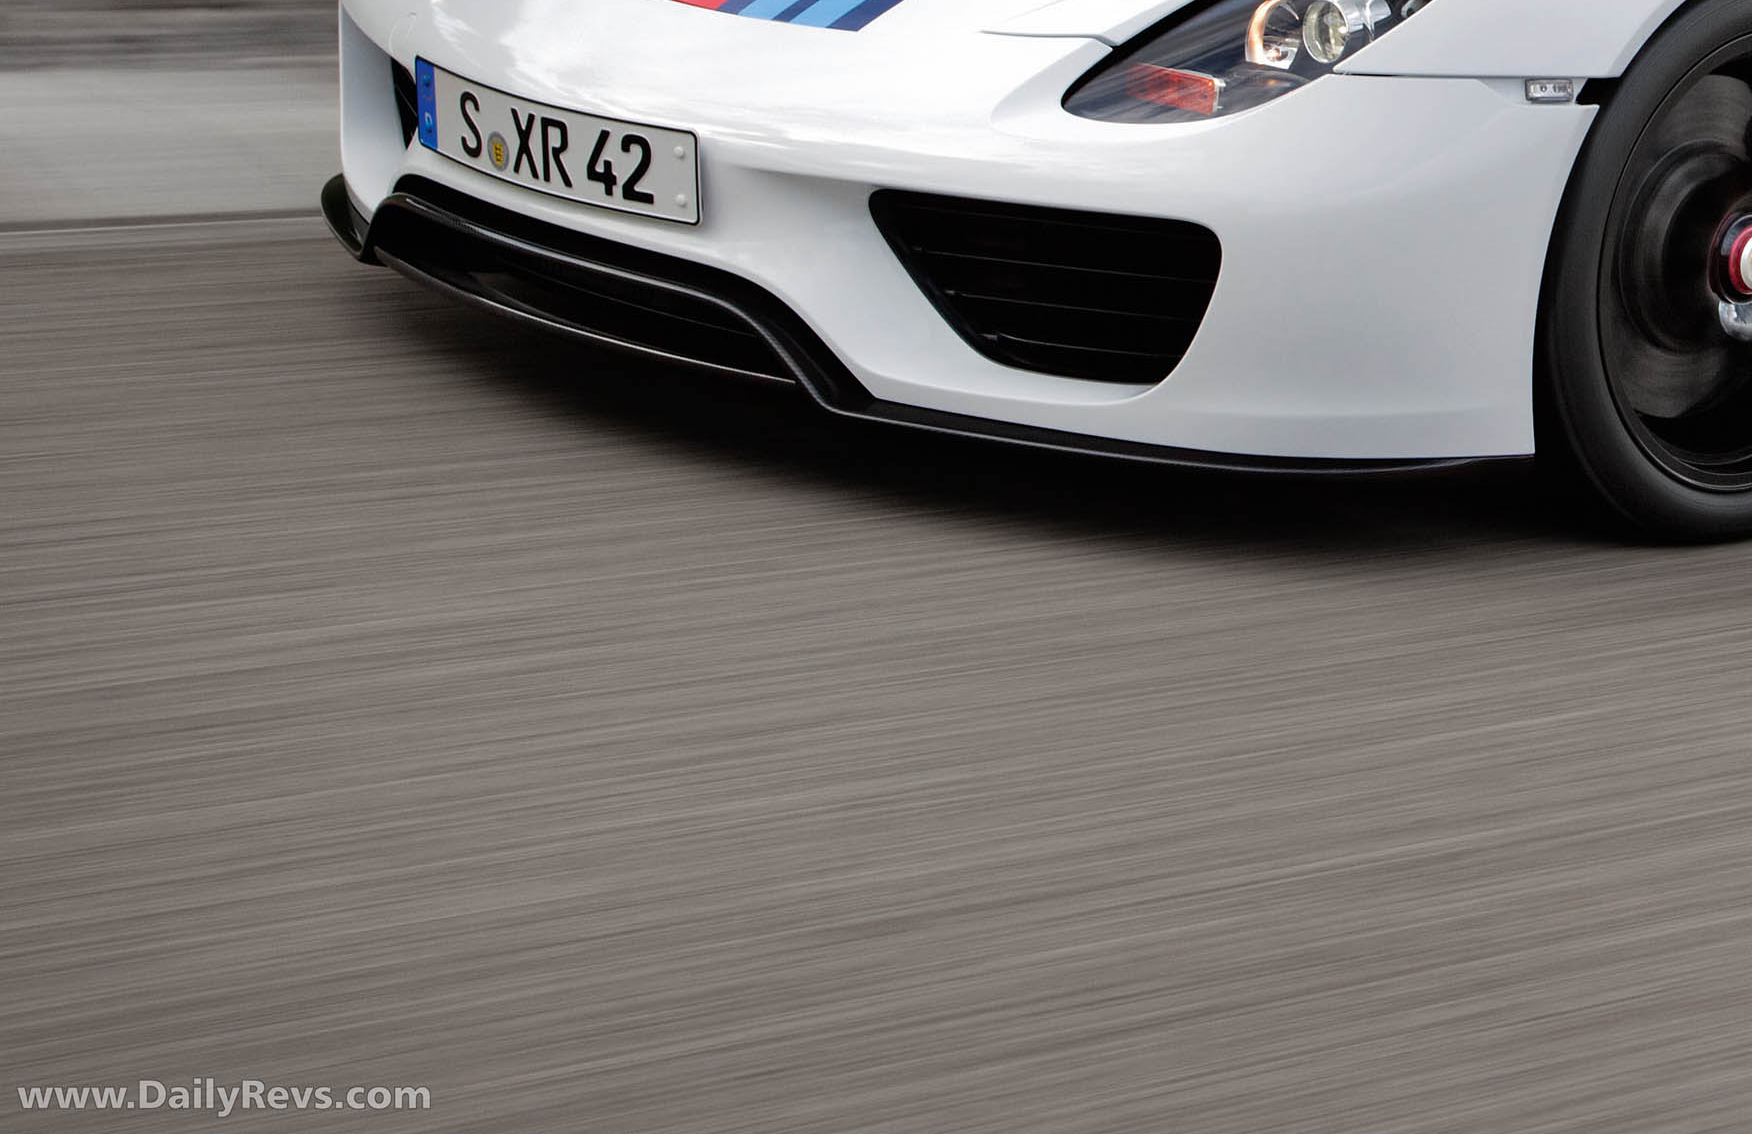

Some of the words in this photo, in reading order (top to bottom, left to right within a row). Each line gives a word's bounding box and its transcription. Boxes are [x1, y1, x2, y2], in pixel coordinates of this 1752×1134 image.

[460, 91, 483, 158] S
[511, 108, 573, 188] XR
[587, 129, 655, 205] 42
